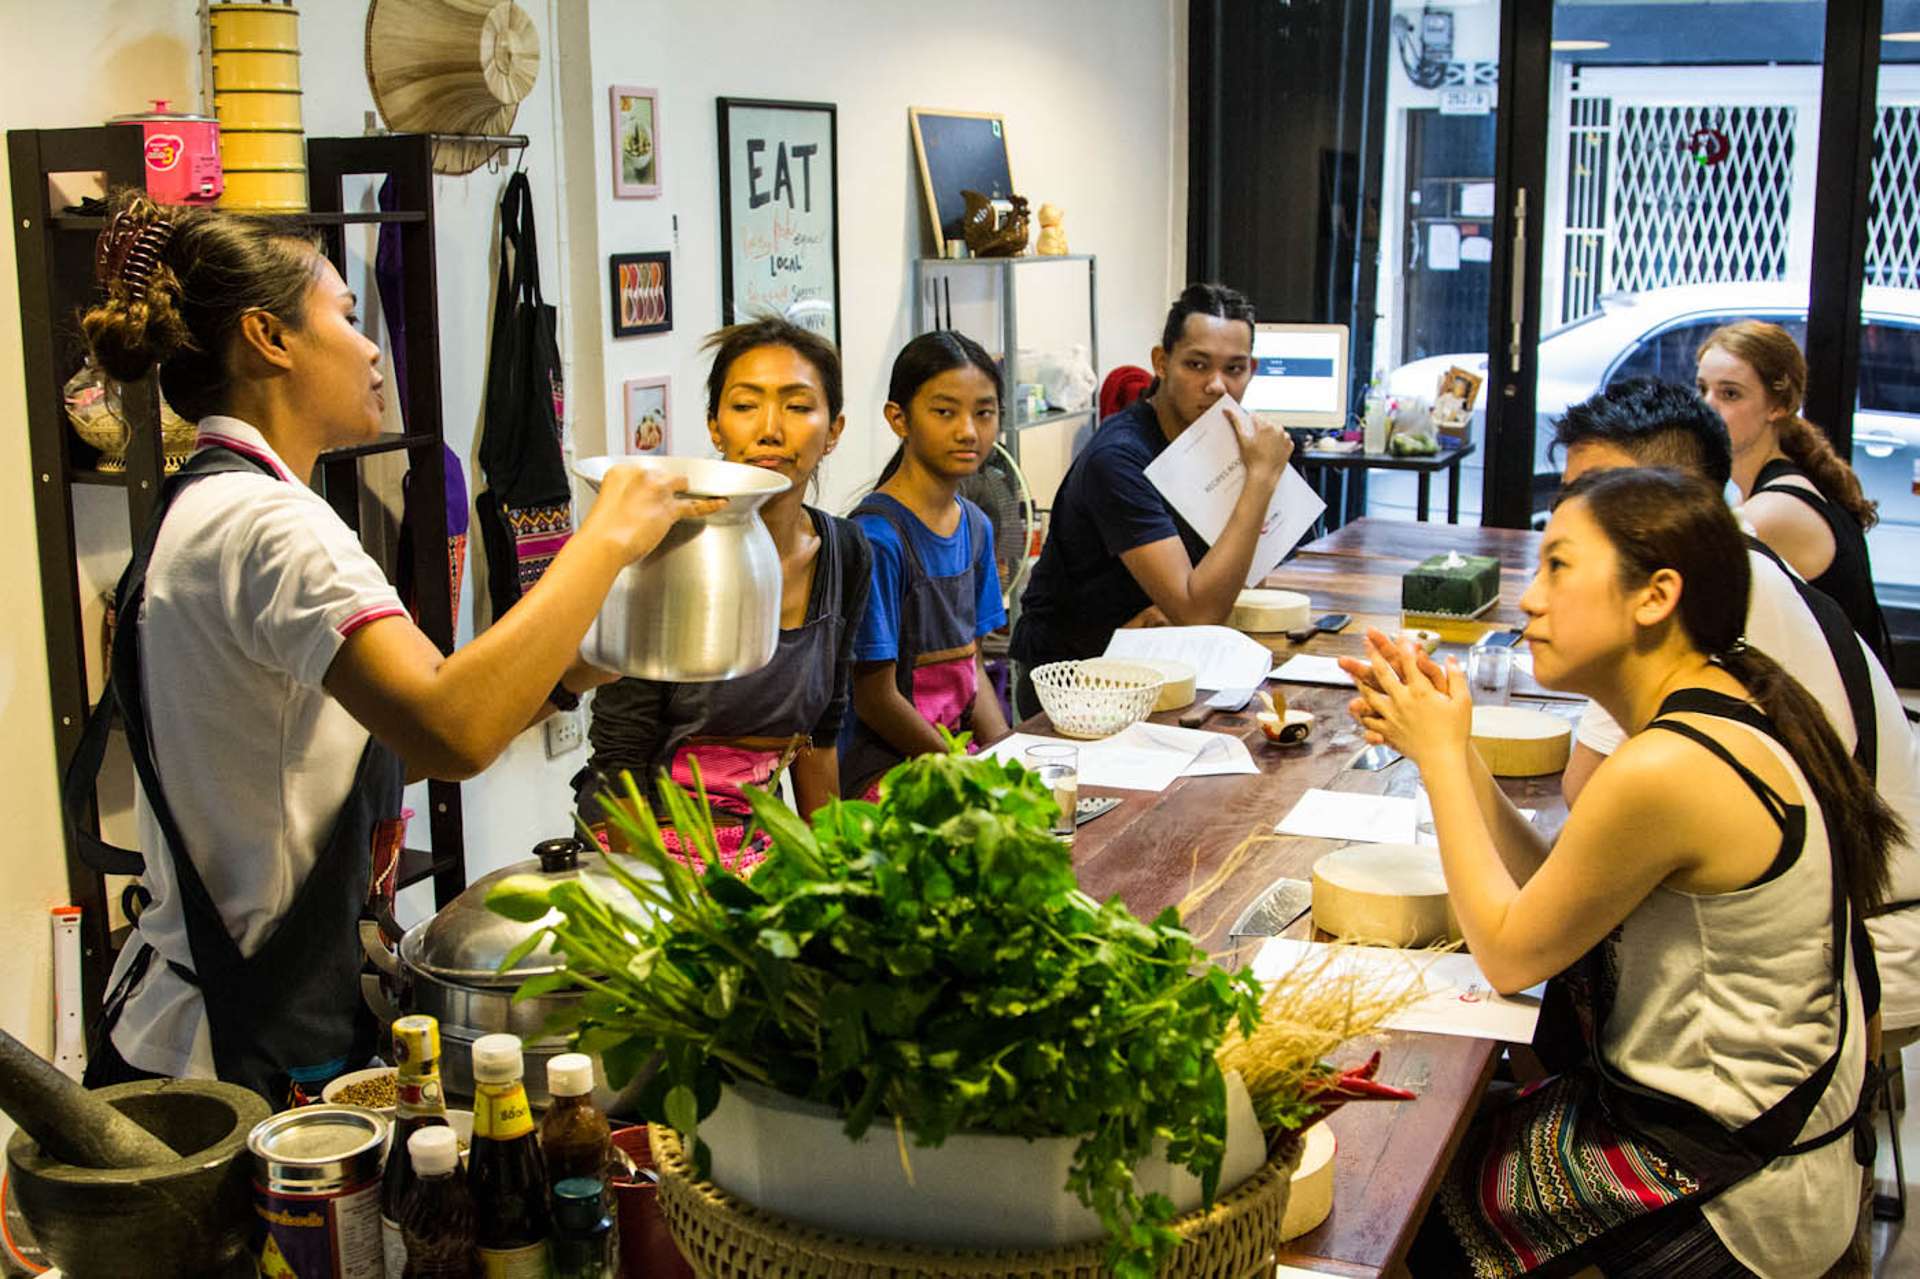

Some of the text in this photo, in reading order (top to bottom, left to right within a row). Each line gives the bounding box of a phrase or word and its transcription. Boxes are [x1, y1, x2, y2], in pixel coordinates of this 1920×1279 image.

[162, 147, 175, 164] 3
[747, 139, 817, 212] EAT
[770, 254, 802, 277] LOCAL
